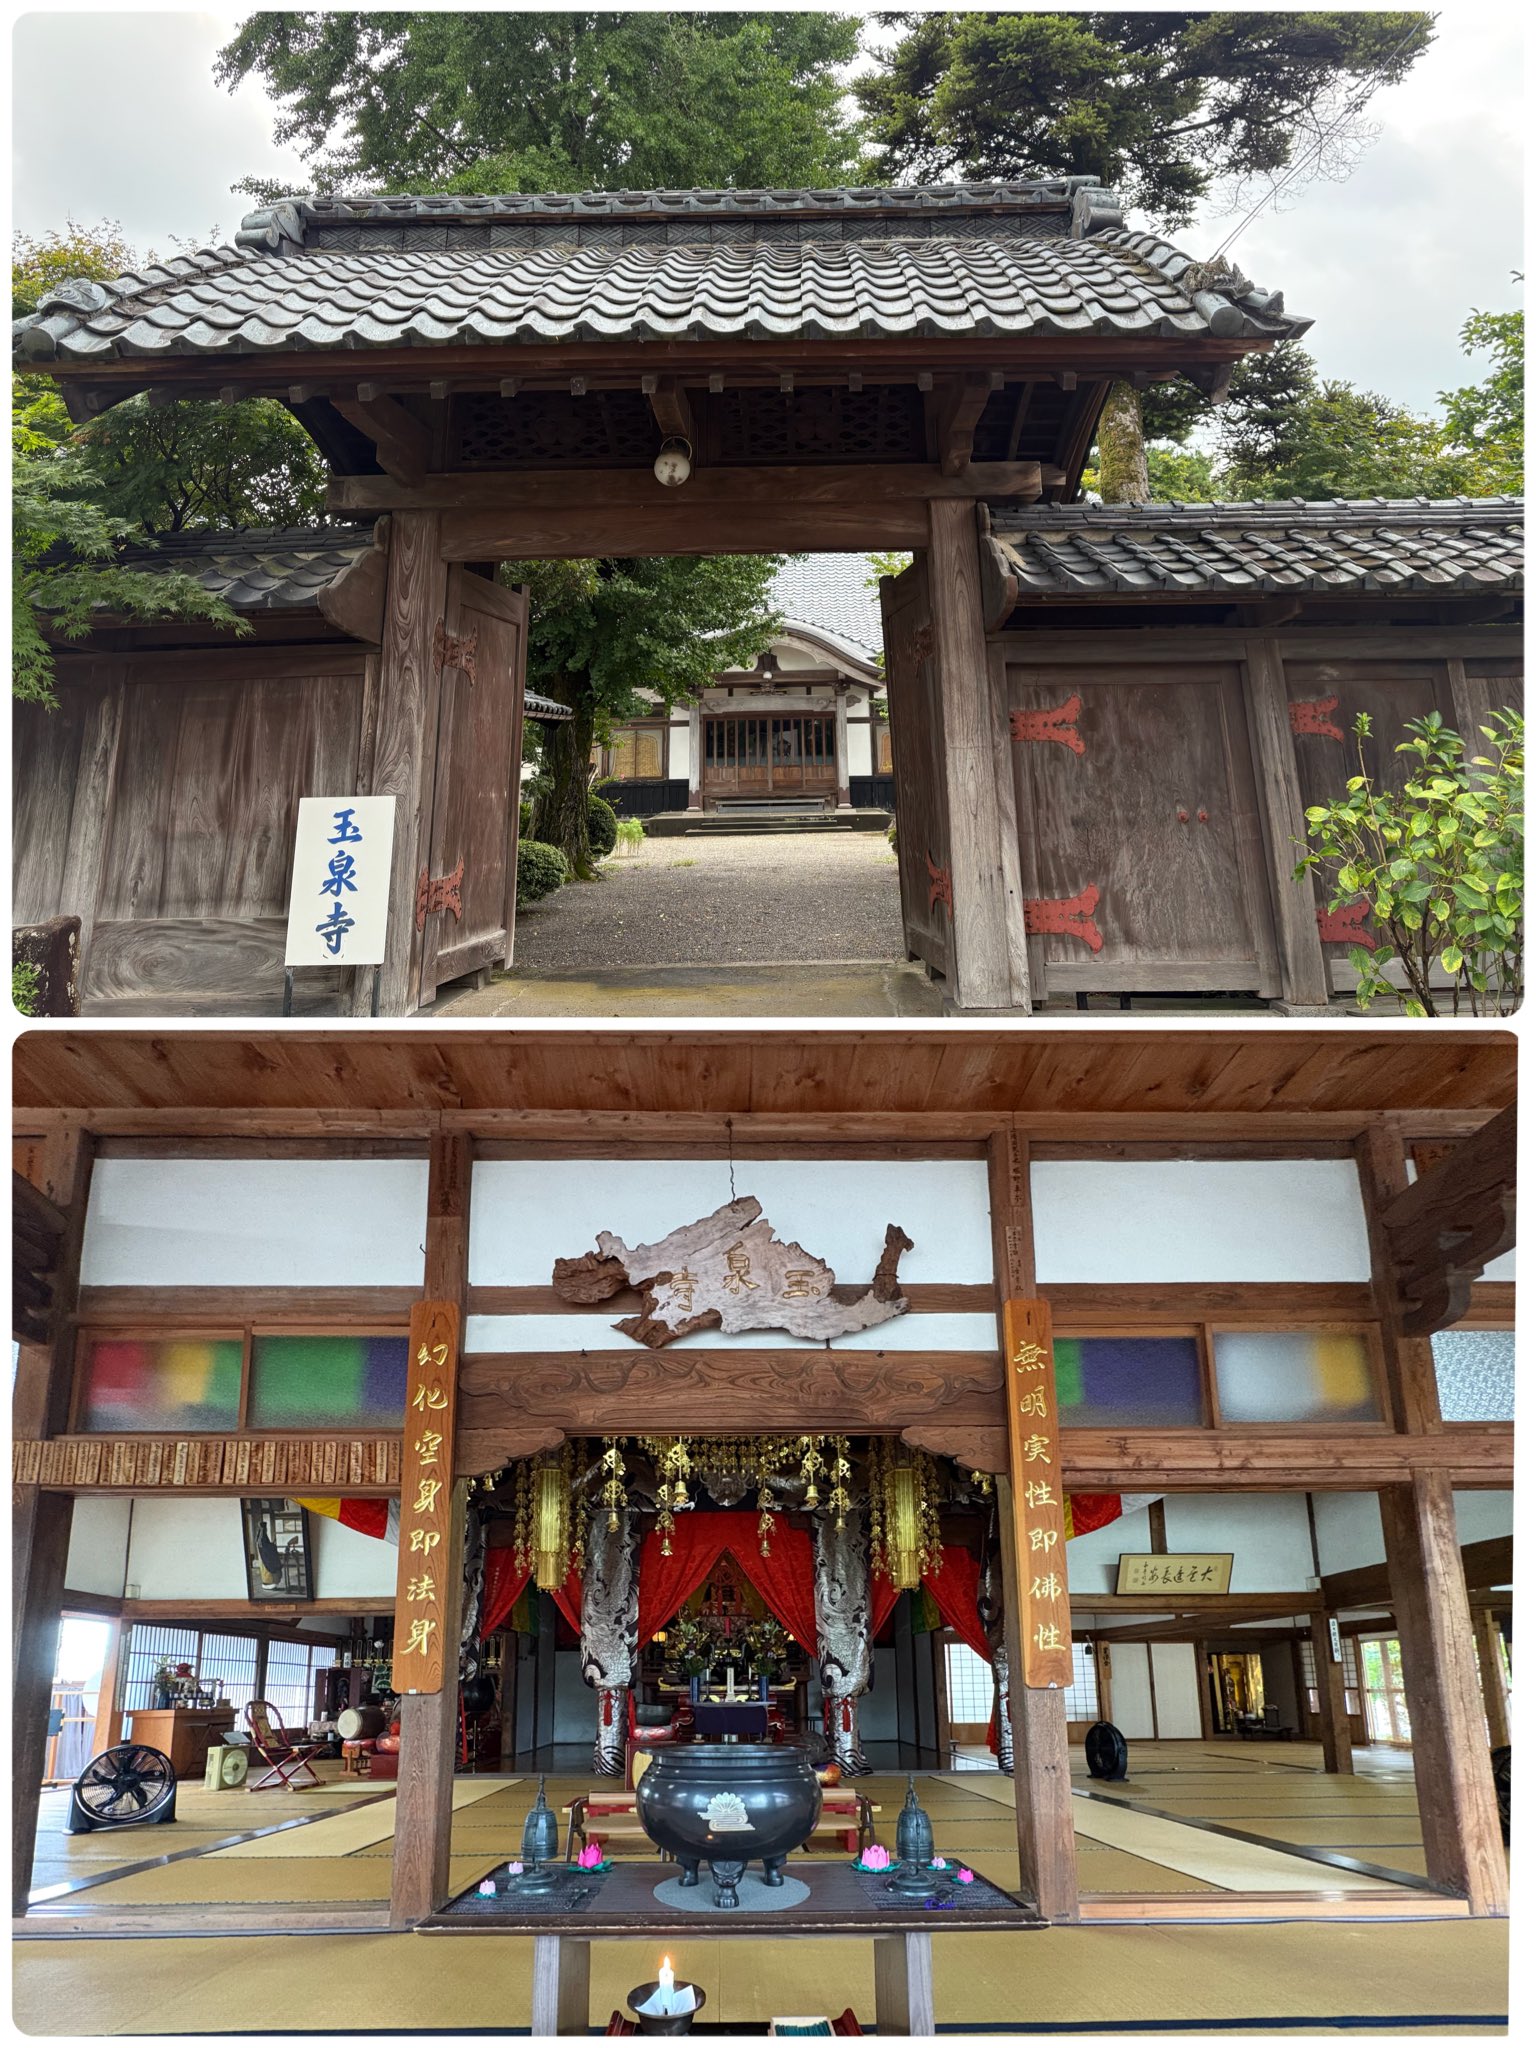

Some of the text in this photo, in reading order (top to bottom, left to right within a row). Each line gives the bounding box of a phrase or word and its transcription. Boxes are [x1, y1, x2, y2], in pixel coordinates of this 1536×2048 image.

[314, 808, 363, 955] 玉泉寺
[669, 1240, 821, 1312] 玉泉寺
[400, 1342, 449, 1657] 幻化空身即法身
[1013, 1340, 1066, 1652] 無明実性即佛性
